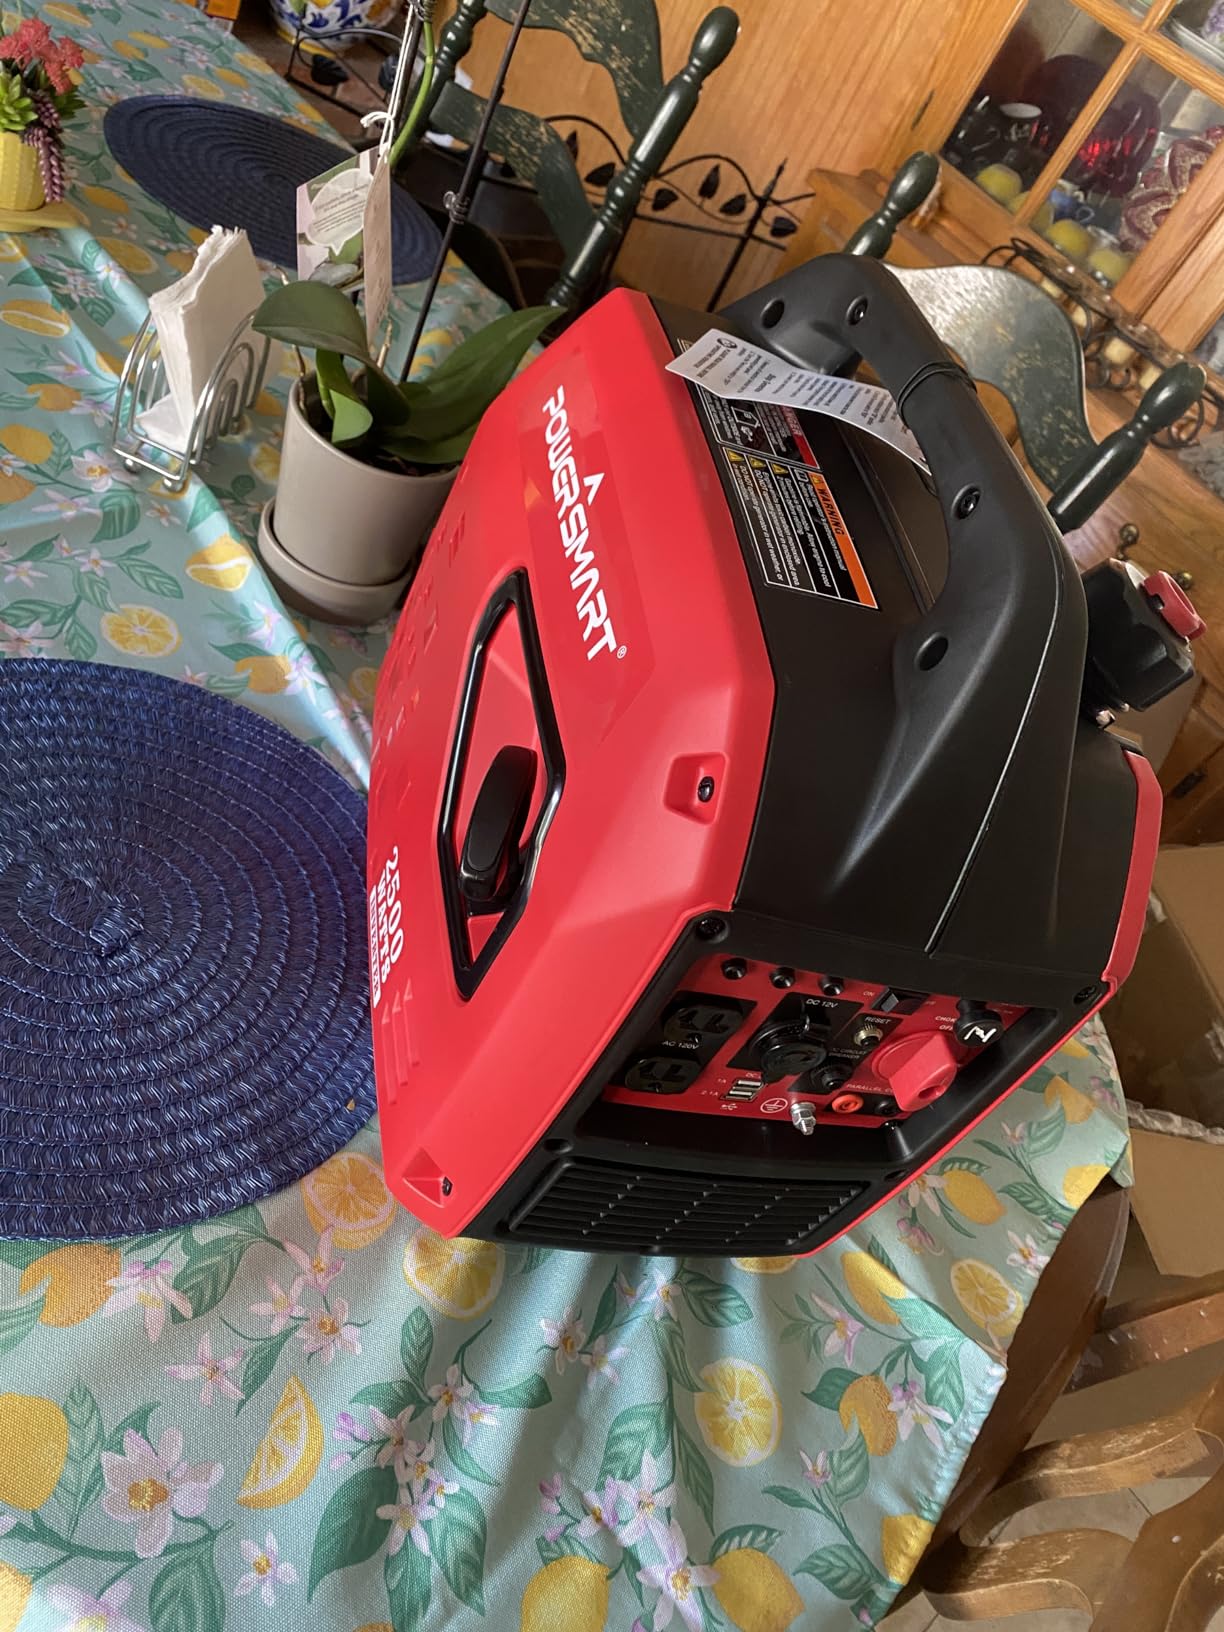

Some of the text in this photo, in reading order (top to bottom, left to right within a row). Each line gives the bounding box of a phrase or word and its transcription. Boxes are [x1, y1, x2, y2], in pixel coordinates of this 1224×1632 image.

[739, 465, 748, 474] DO
[743, 474, 753, 486] NOT
[818, 488, 843, 534] WARNING
[543, 385, 618, 661] POWERSMART
[752, 505, 767, 531] generator
[754, 469, 762, 478] DO
[758, 478, 768, 491] NOT
[781, 543, 795, 570] enclosed
[765, 537, 773, 548] wet
[806, 532, 815, 547] Allow
[812, 547, 822, 567] engine
[821, 573, 831, 587] cool
[386, 846, 404, 964] 2500
[377, 869, 391, 983] WATTS
[806, 998, 839, 1009] DC 12V
[864, 1016, 891, 1024] RESET
[935, 1015, 957, 1023] CHOK
[678, 1042, 700, 1050] 120V
[847, 1084, 882, 1092] PARALLEL
